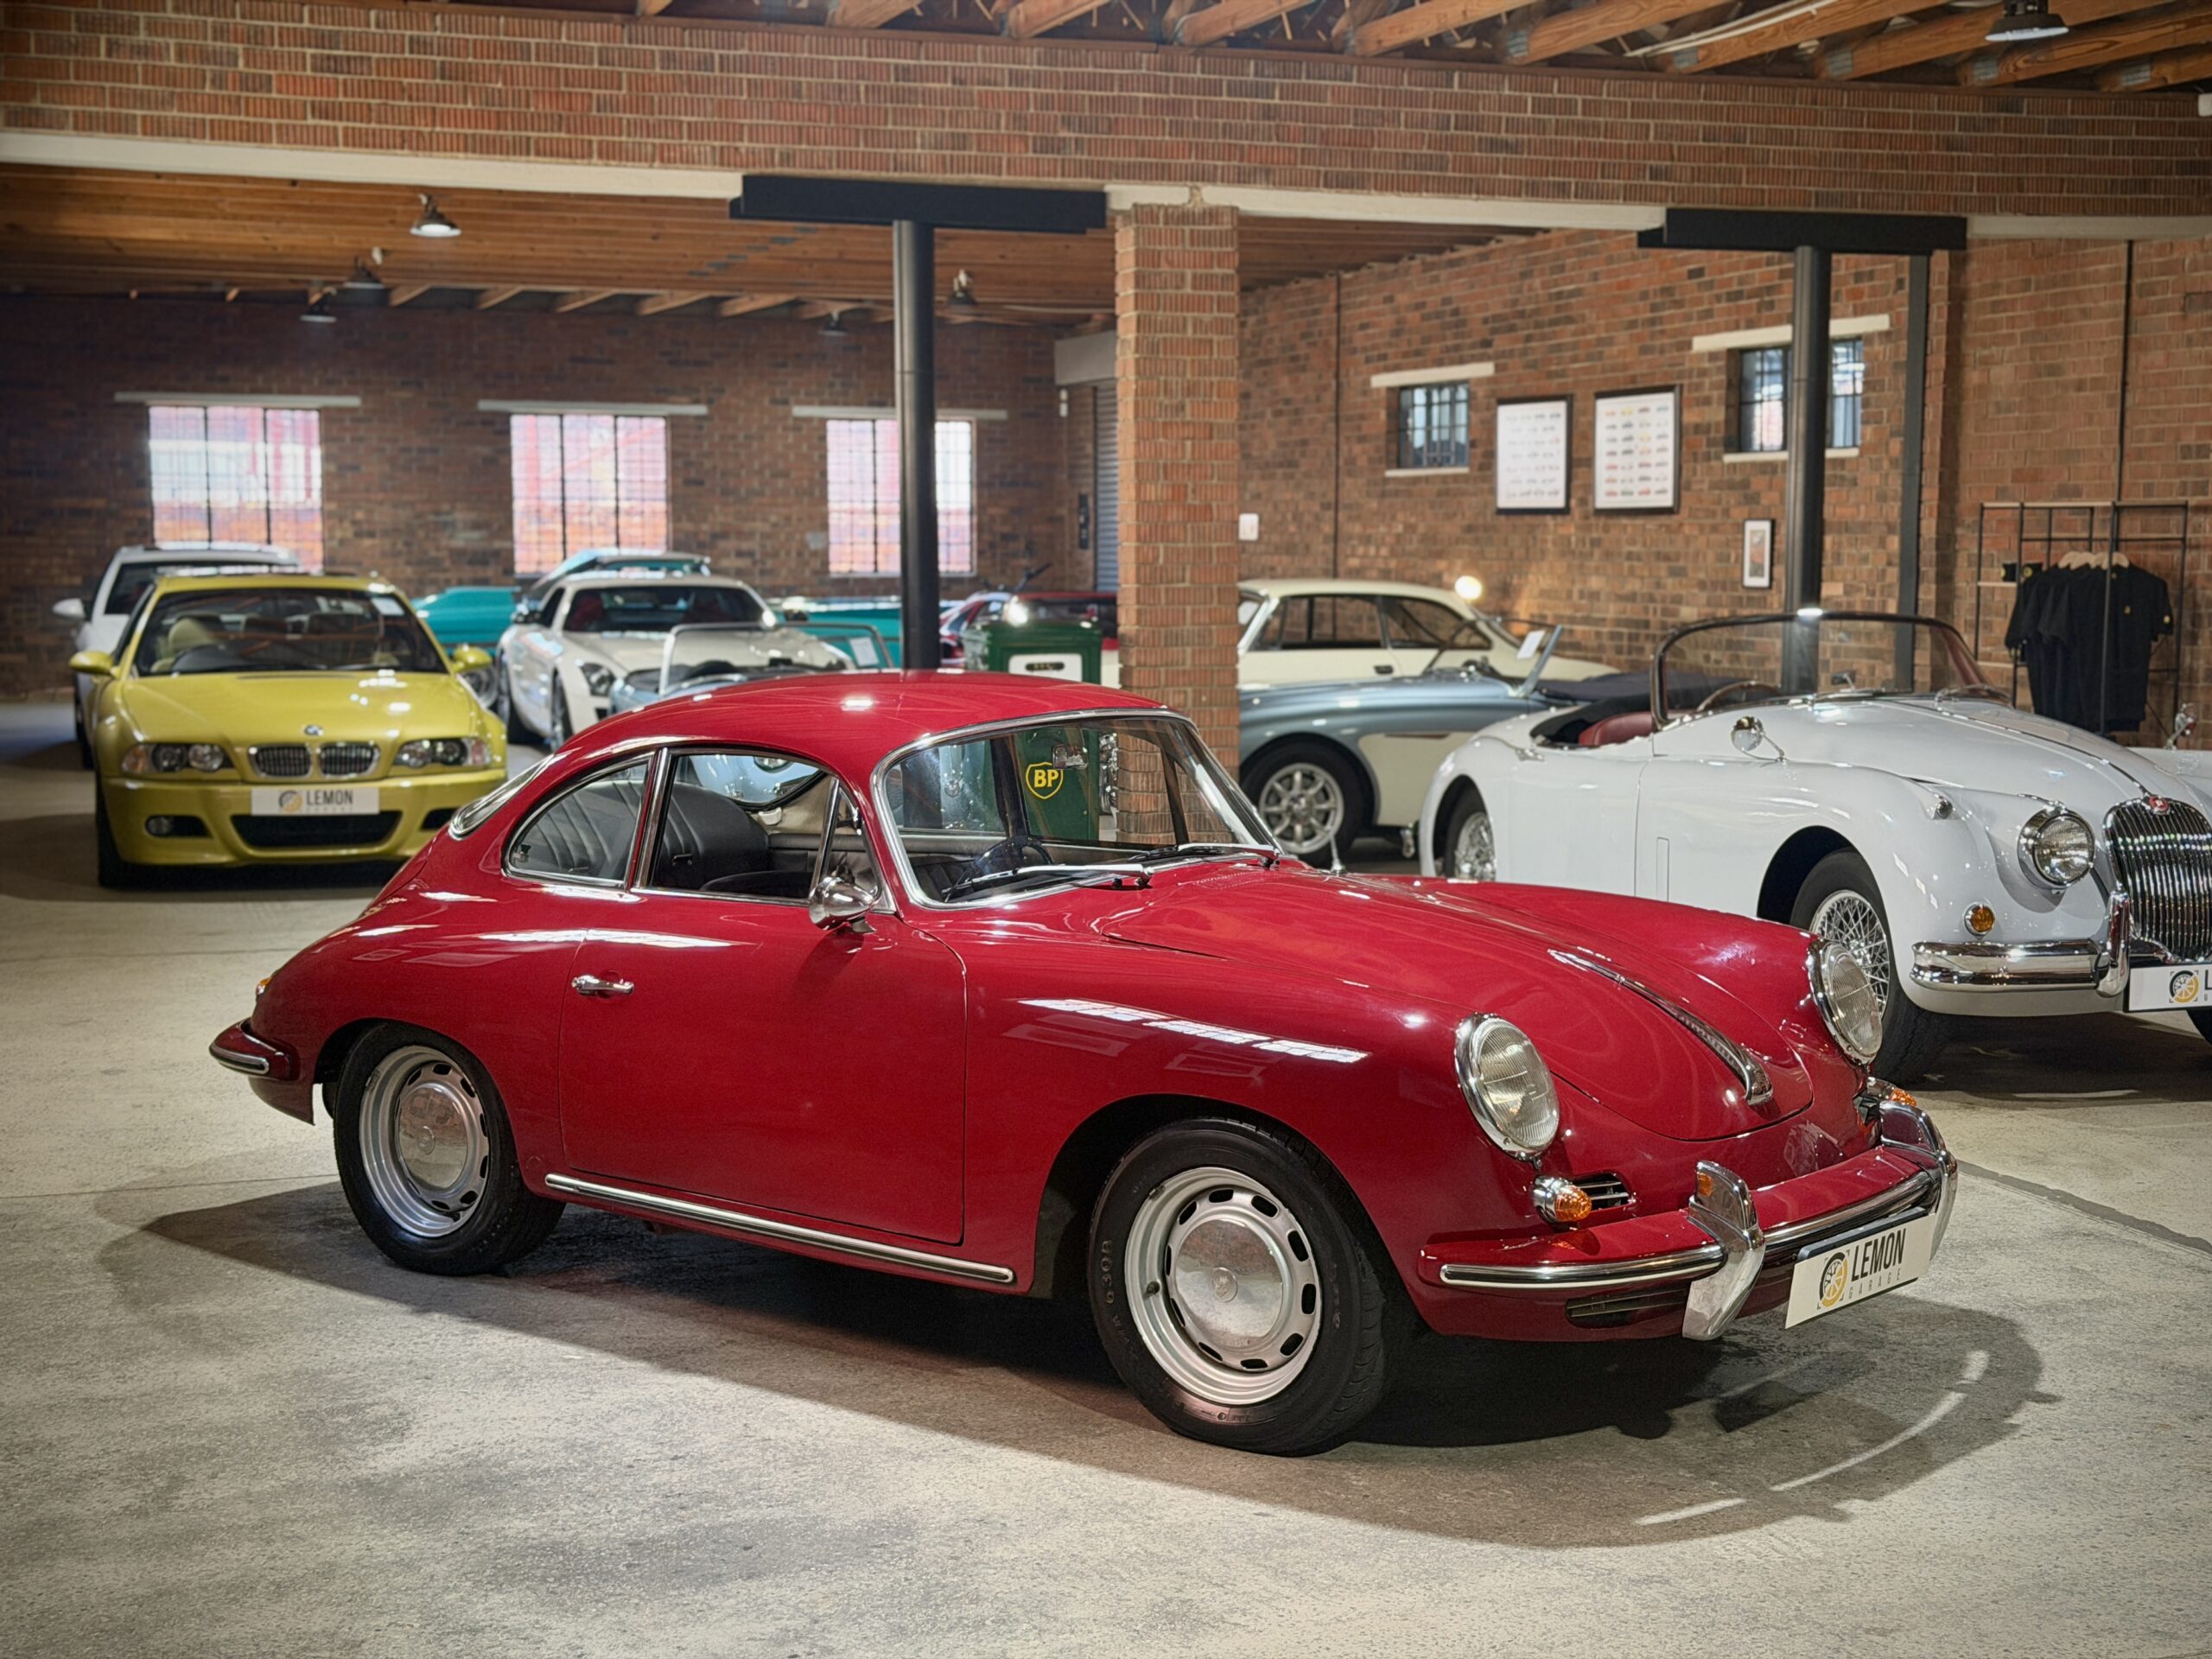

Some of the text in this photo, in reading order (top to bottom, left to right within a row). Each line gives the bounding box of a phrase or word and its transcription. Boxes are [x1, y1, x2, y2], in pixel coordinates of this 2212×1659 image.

[1033, 769, 1059, 788] BP
[306, 790, 353, 805] LEMON
[1851, 1228, 1907, 1281] LEMON
[1848, 1268, 1902, 1300] GARAGE
